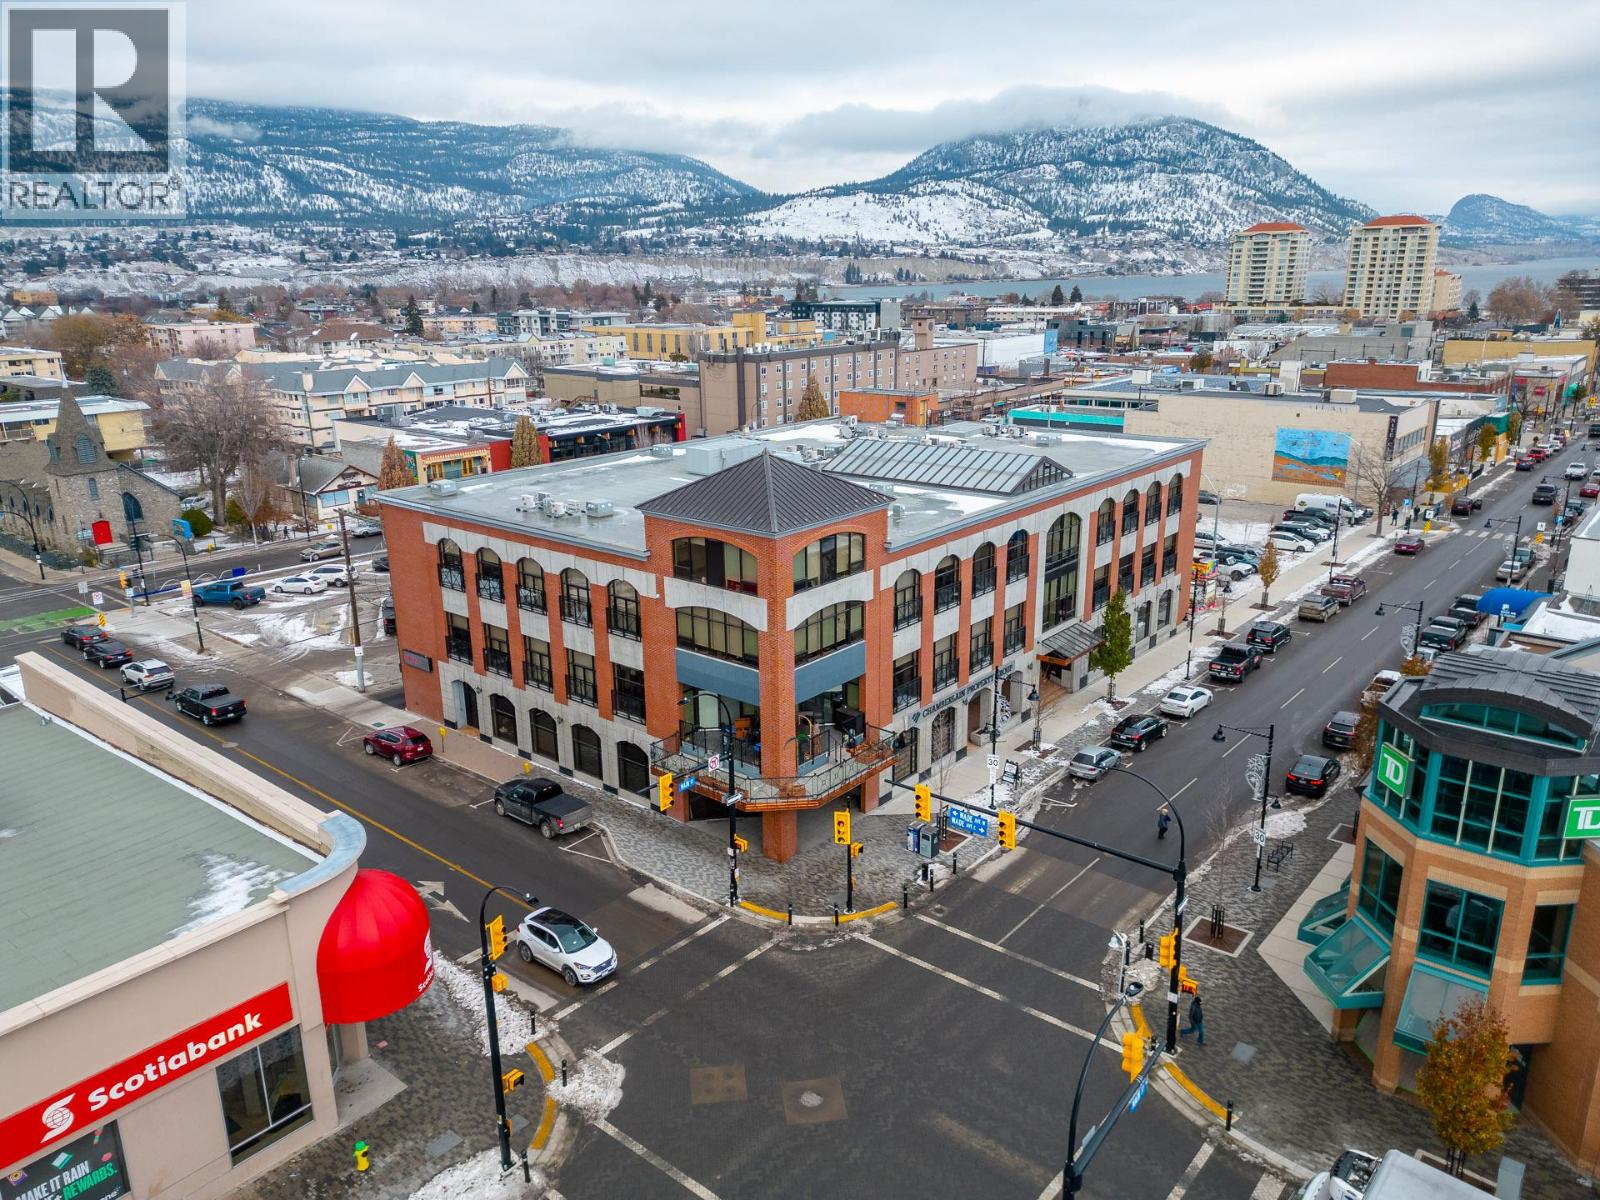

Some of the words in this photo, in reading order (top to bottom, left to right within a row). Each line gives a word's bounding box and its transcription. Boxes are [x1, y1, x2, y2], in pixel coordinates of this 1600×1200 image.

[922, 689, 966, 718] CHAMBERLAIN
[966, 674, 994, 695] PROPERTY
[988, 758, 998, 766] 30
[1383, 753, 1404, 785] TD
[951, 816, 965, 828] WADE
[960, 812, 973, 823] WADE
[1254, 831, 1264, 842] 30
[88, 1012, 263, 1112] Scotiabank
[49, 1174, 61, 1191] IT
[62, 1160, 90, 1186] RAIN
[62, 1162, 118, 1200] REWARDS.
